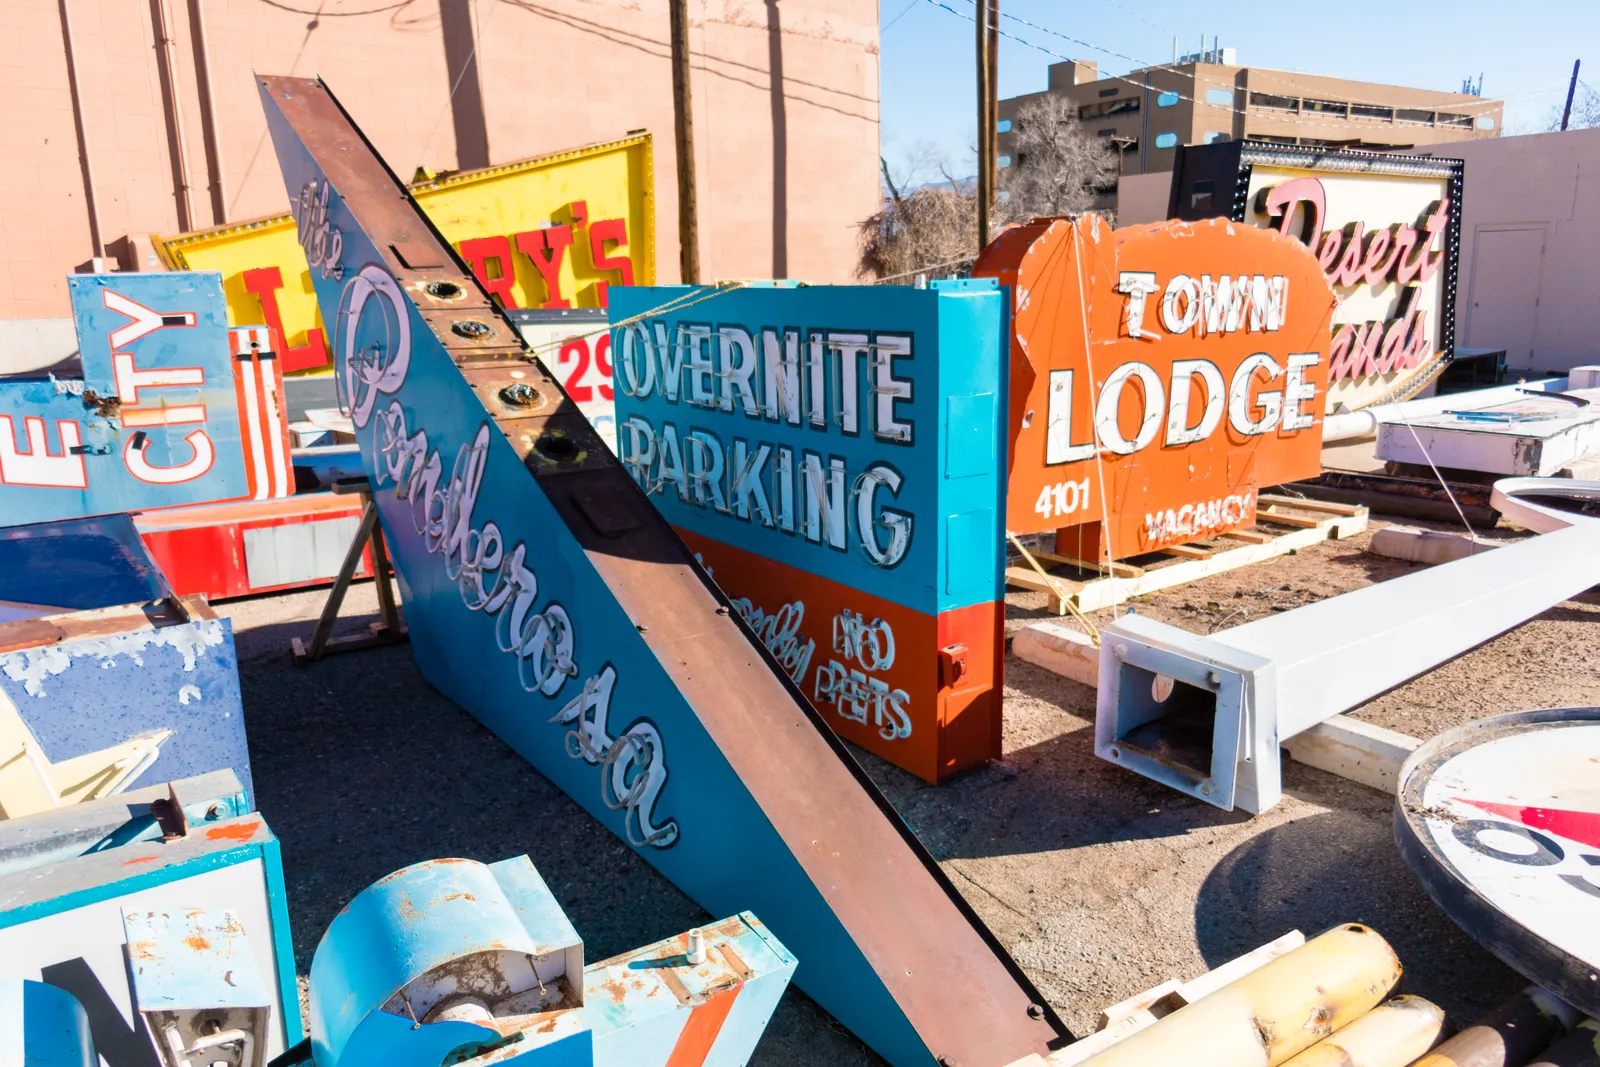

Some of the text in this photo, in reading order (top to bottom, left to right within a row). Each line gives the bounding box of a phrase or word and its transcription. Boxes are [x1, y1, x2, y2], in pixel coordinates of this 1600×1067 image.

[1265, 177, 1450, 288] Desert
[1112, 270, 1290, 342] TOWN
[1329, 286, 1432, 382] ands
[102, 287, 215, 485] CITY
[614, 319, 914, 446] OVERNITE
[1045, 351, 1325, 468] LODGE
[620, 414, 915, 570] PARKING
[1034, 477, 1090, 519] 4101
[1145, 492, 1252, 542] VACANCY
[333, 261, 680, 849] Ponderosa
[832, 608, 896, 671] NO
[814, 659, 912, 740] PETS
